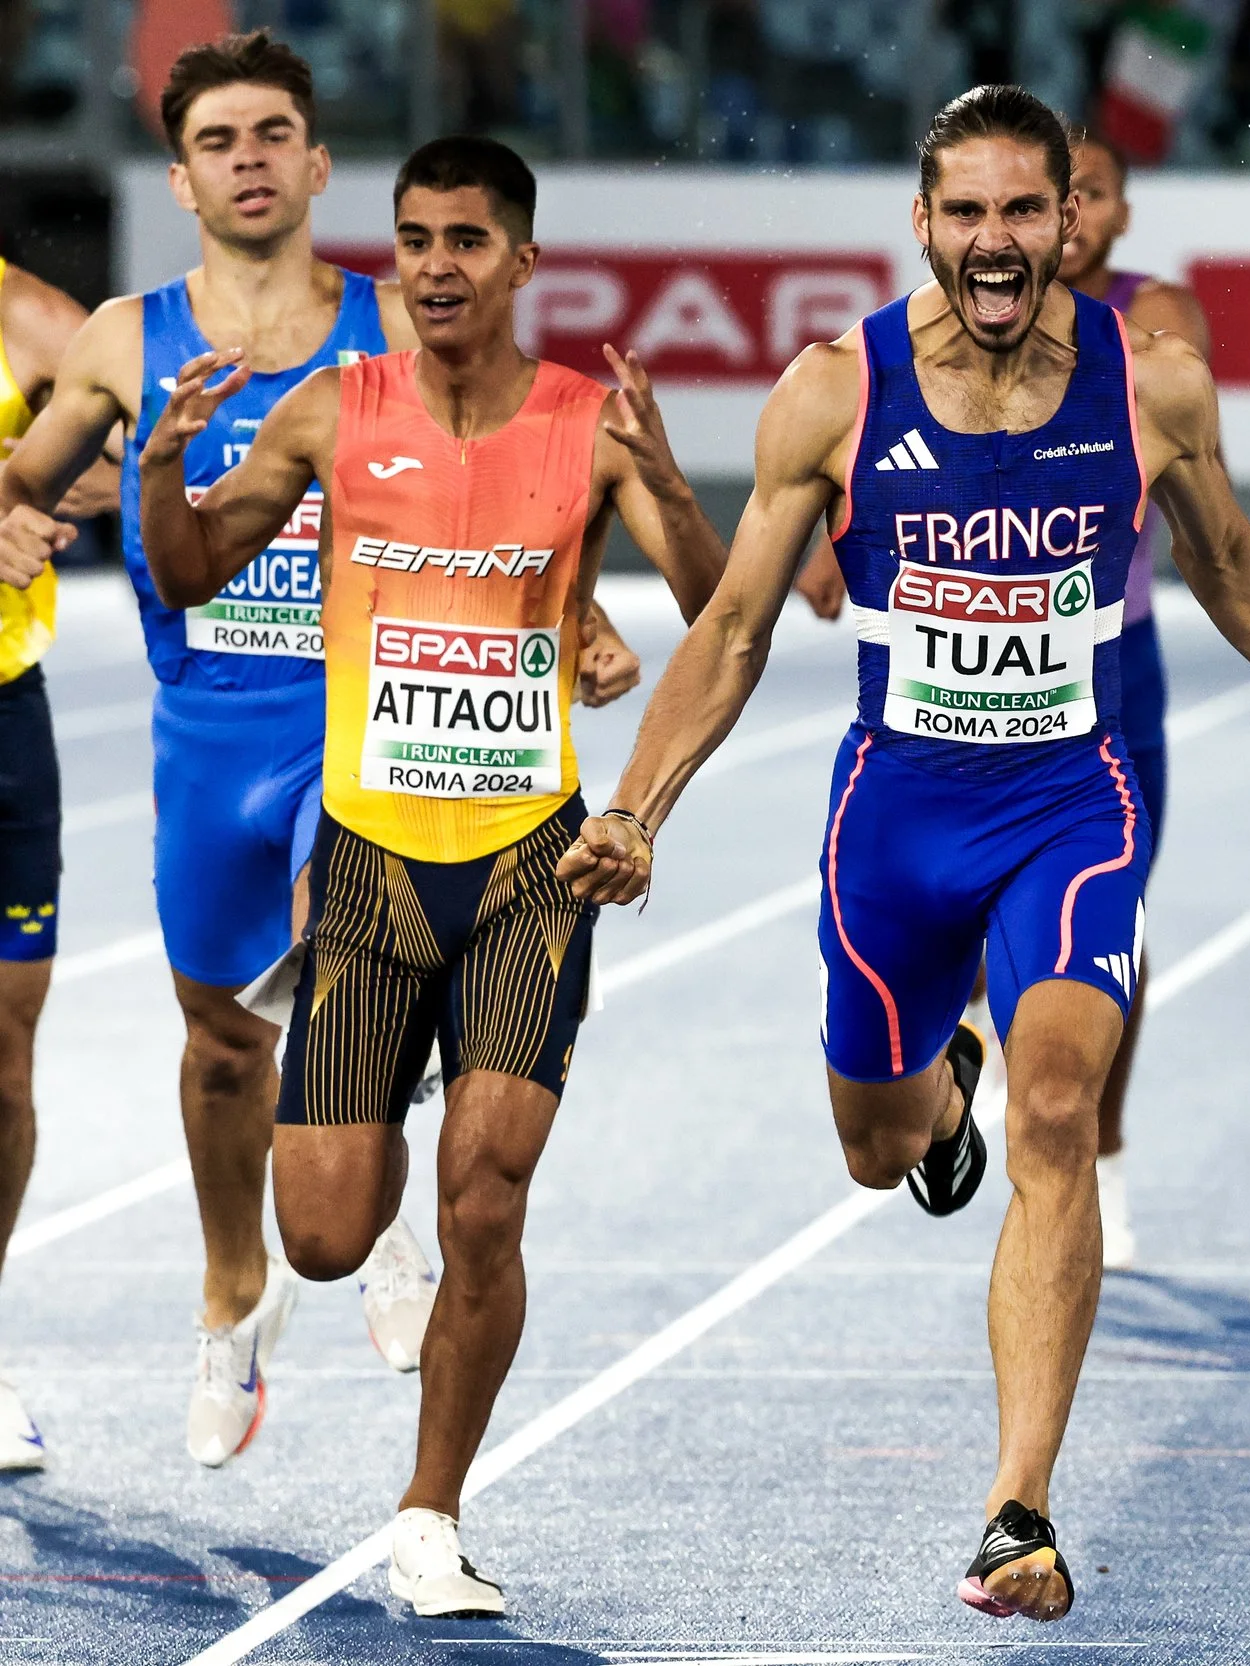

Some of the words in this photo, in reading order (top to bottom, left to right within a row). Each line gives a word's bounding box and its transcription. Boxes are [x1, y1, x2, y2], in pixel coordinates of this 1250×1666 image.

[380, 271, 876, 366] PAR
[1033, 446, 1068, 460] Crédit
[1079, 440, 1114, 454] Mutuel
[895, 504, 1105, 562] FRANCE
[350, 536, 554, 578] ESPAÑA
[899, 573, 1045, 617] SPAR
[235, 607, 273, 623] RUN
[275, 608, 321, 625] CLEA
[214, 626, 289, 649] ROMA
[296, 633, 324, 652] 20
[378, 629, 514, 672] SPAR
[915, 624, 1067, 677] TUAL
[373, 680, 552, 733] ATTAOUI
[931, 687, 935, 702] I
[939, 689, 981, 708] RUN
[914, 708, 998, 738] ROMA
[1005, 710, 1068, 738] 2024
[402, 743, 407, 758] I
[411, 745, 451, 762] RUN
[389, 766, 466, 792] ROMA
[472, 773, 533, 792] 2024
